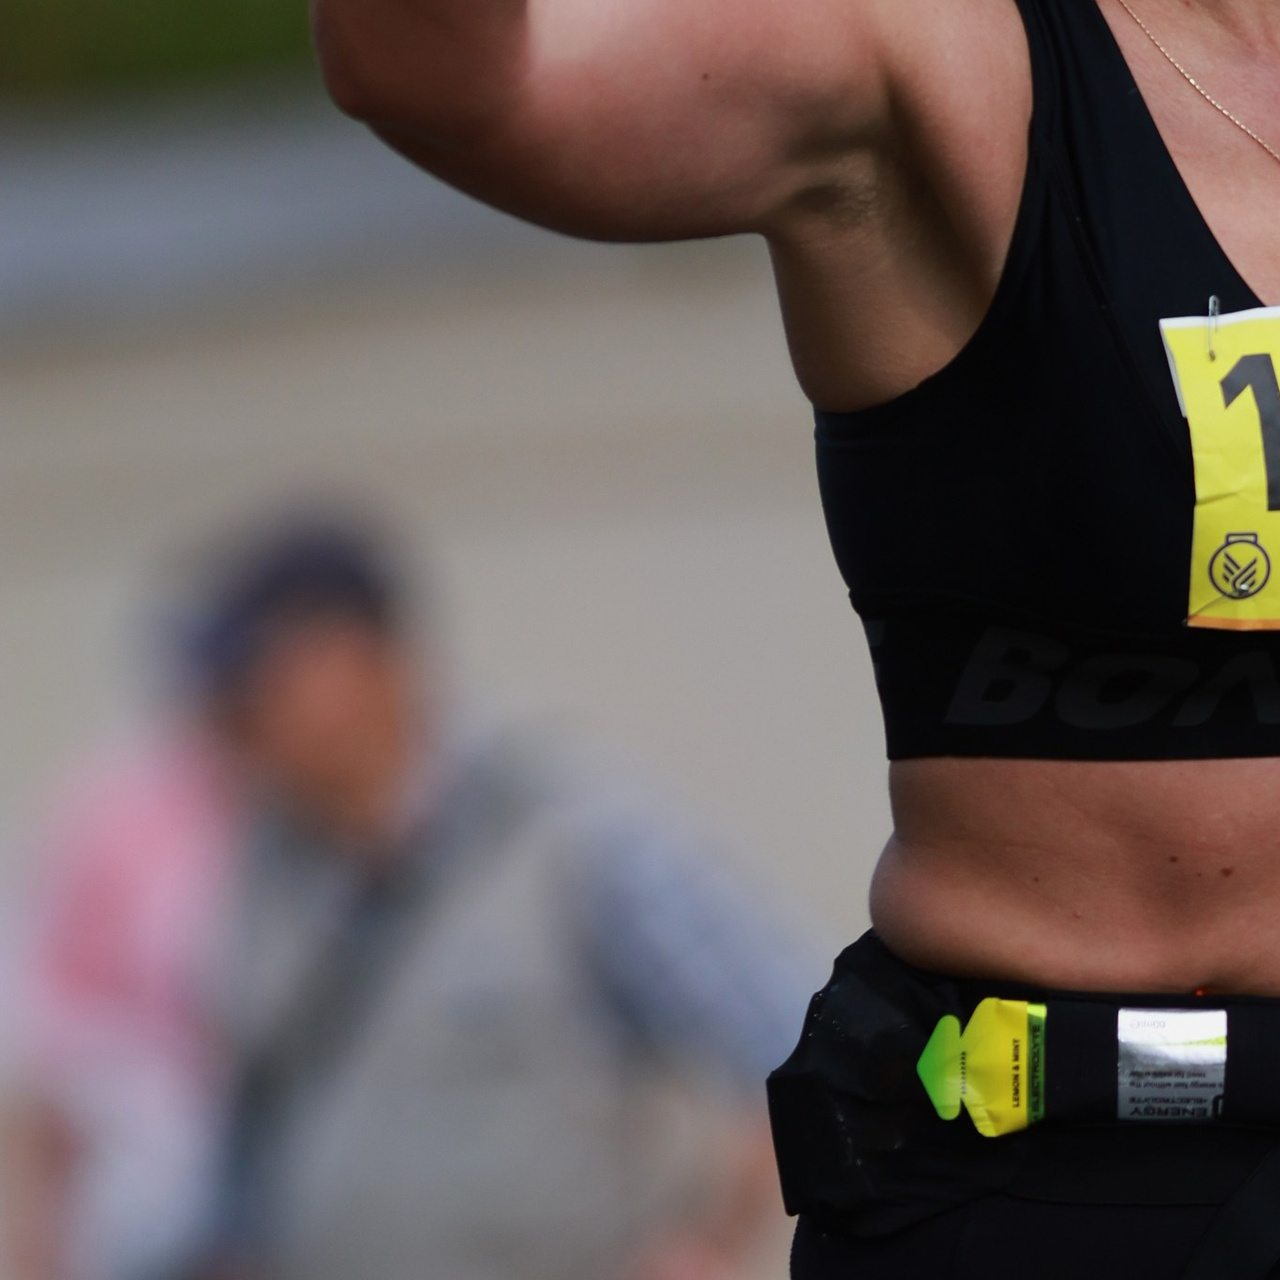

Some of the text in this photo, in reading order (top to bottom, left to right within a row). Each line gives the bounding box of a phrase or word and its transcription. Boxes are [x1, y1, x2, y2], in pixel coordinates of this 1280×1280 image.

[1012, 1038, 1020, 1062] MINT
[1012, 1074, 1020, 1108] LEMON
[1130, 1106, 1208, 1116] ENERGY
